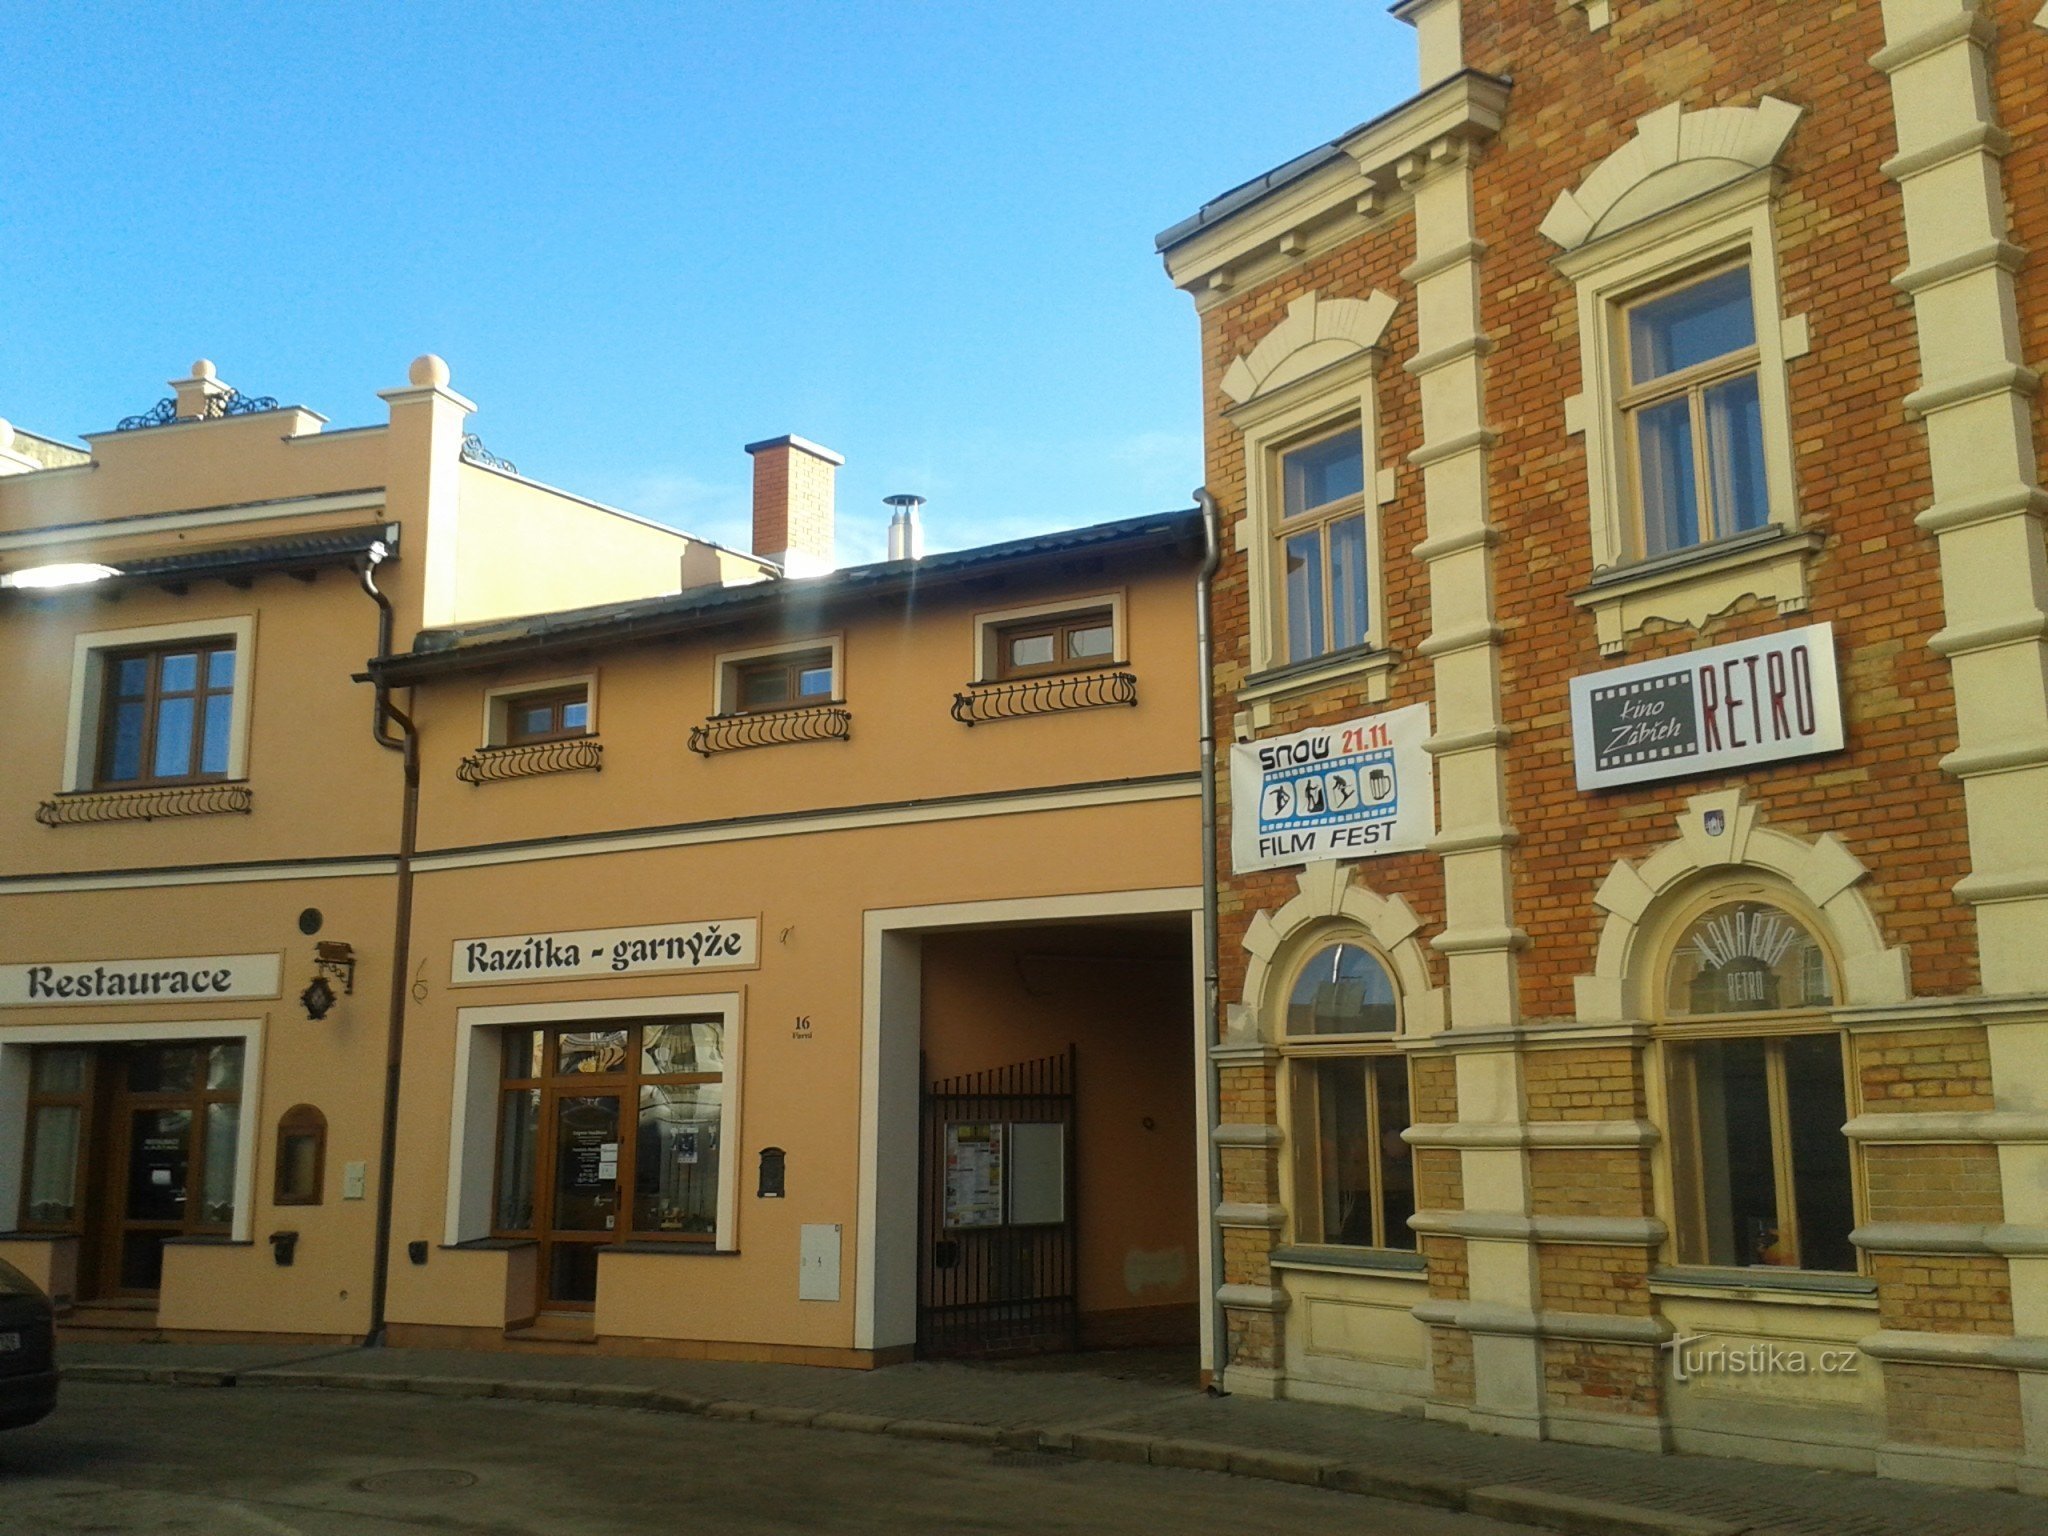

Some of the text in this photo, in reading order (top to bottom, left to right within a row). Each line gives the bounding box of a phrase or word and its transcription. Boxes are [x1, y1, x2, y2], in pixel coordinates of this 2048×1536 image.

[1620, 700, 1665, 720] kino
[1699, 645, 1816, 752] RETRO
[1341, 722, 1393, 755] 21.11.
[1602, 717, 1682, 754] Zábřeh
[1259, 820, 1398, 858] FILM FEST
[466, 937, 581, 974] Razítka
[611, 925, 742, 971] garnyže
[1692, 904, 1796, 970] KAVÁRNA
[27, 966, 232, 999] Restaurace
[1727, 970, 1764, 1001] RETRO
[796, 1015, 810, 1030] 16
